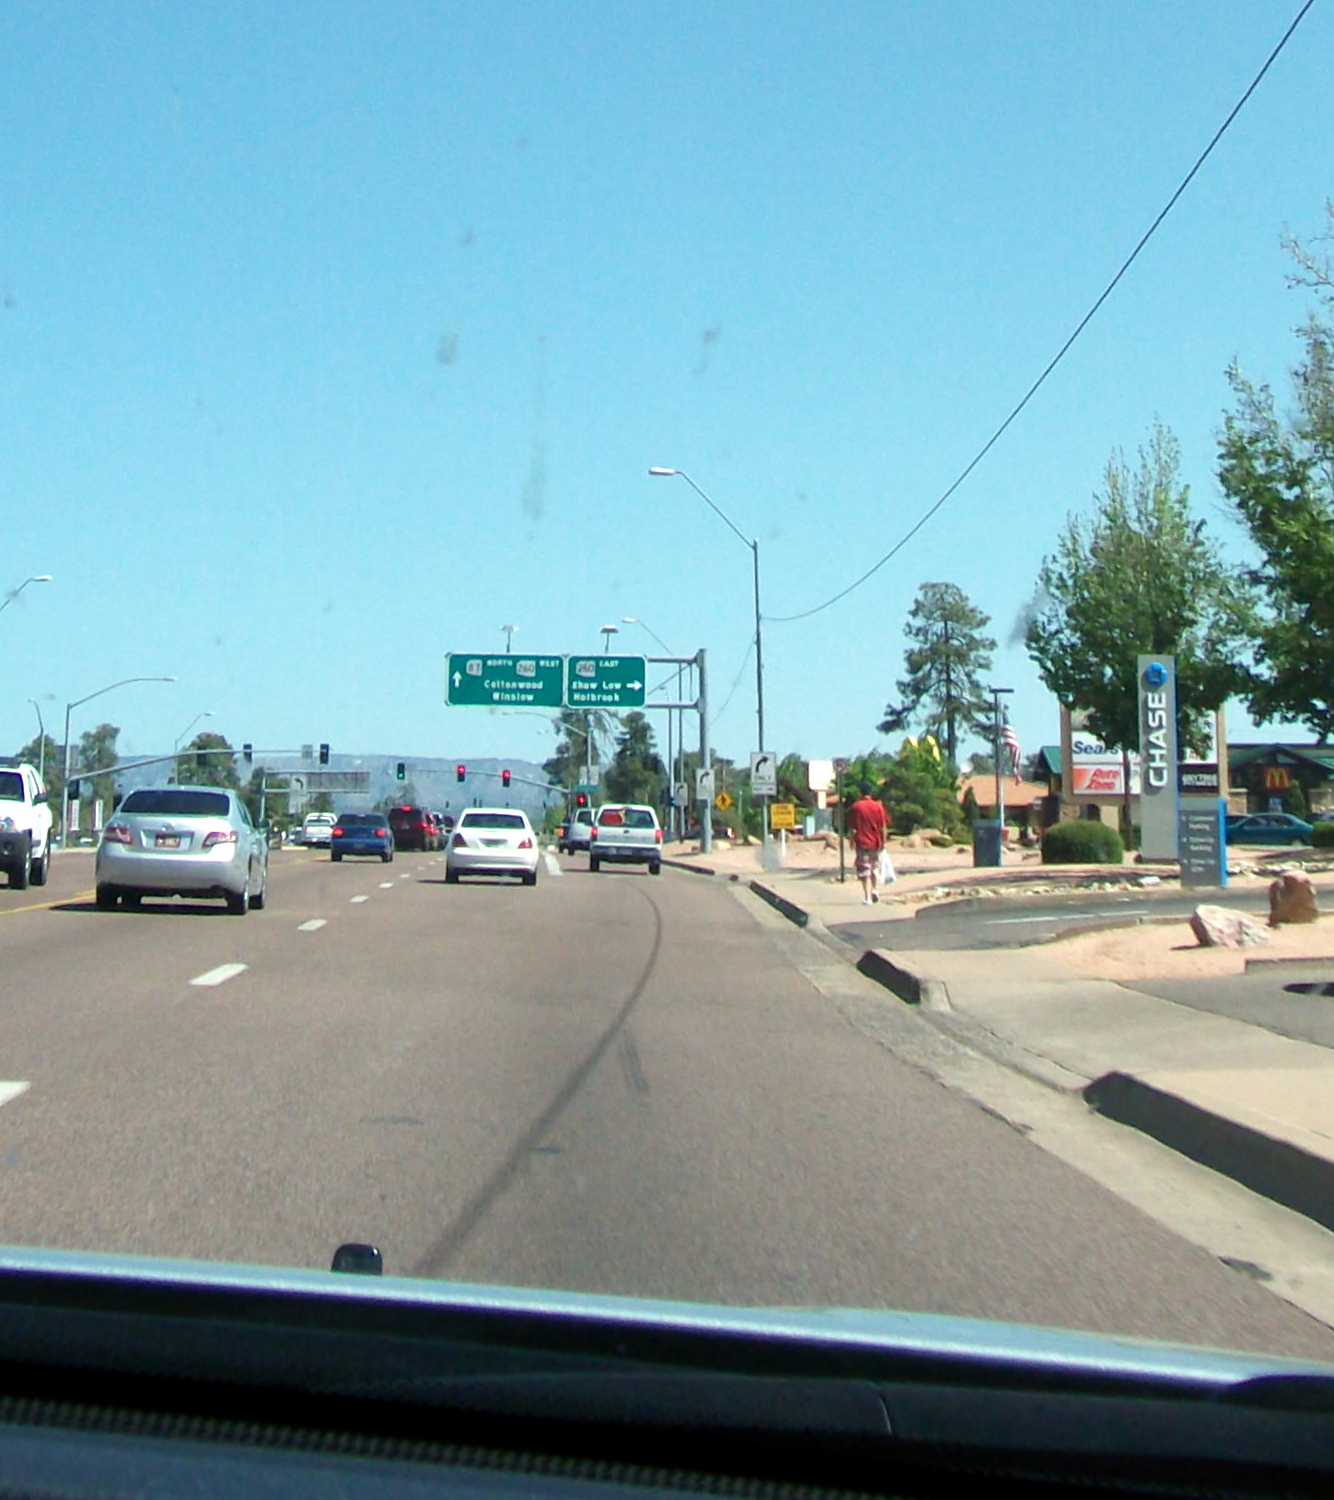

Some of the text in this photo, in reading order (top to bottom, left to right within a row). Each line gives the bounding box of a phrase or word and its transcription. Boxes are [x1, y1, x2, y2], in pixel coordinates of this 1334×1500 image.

[486, 659, 513, 667] NORTH
[517, 663, 534, 673] 260
[539, 659, 560, 668] WEST
[598, 659, 620, 668] EAST
[483, 679, 544, 690] Cottonwood
[571, 680, 622, 690] Show Low
[492, 691, 535, 702] Winslow
[572, 691, 620, 702] Holbrook
[1147, 691, 1168, 787] CHASE
[1092, 767, 1121, 779] Auto
[1085, 779, 1117, 790] Zone
